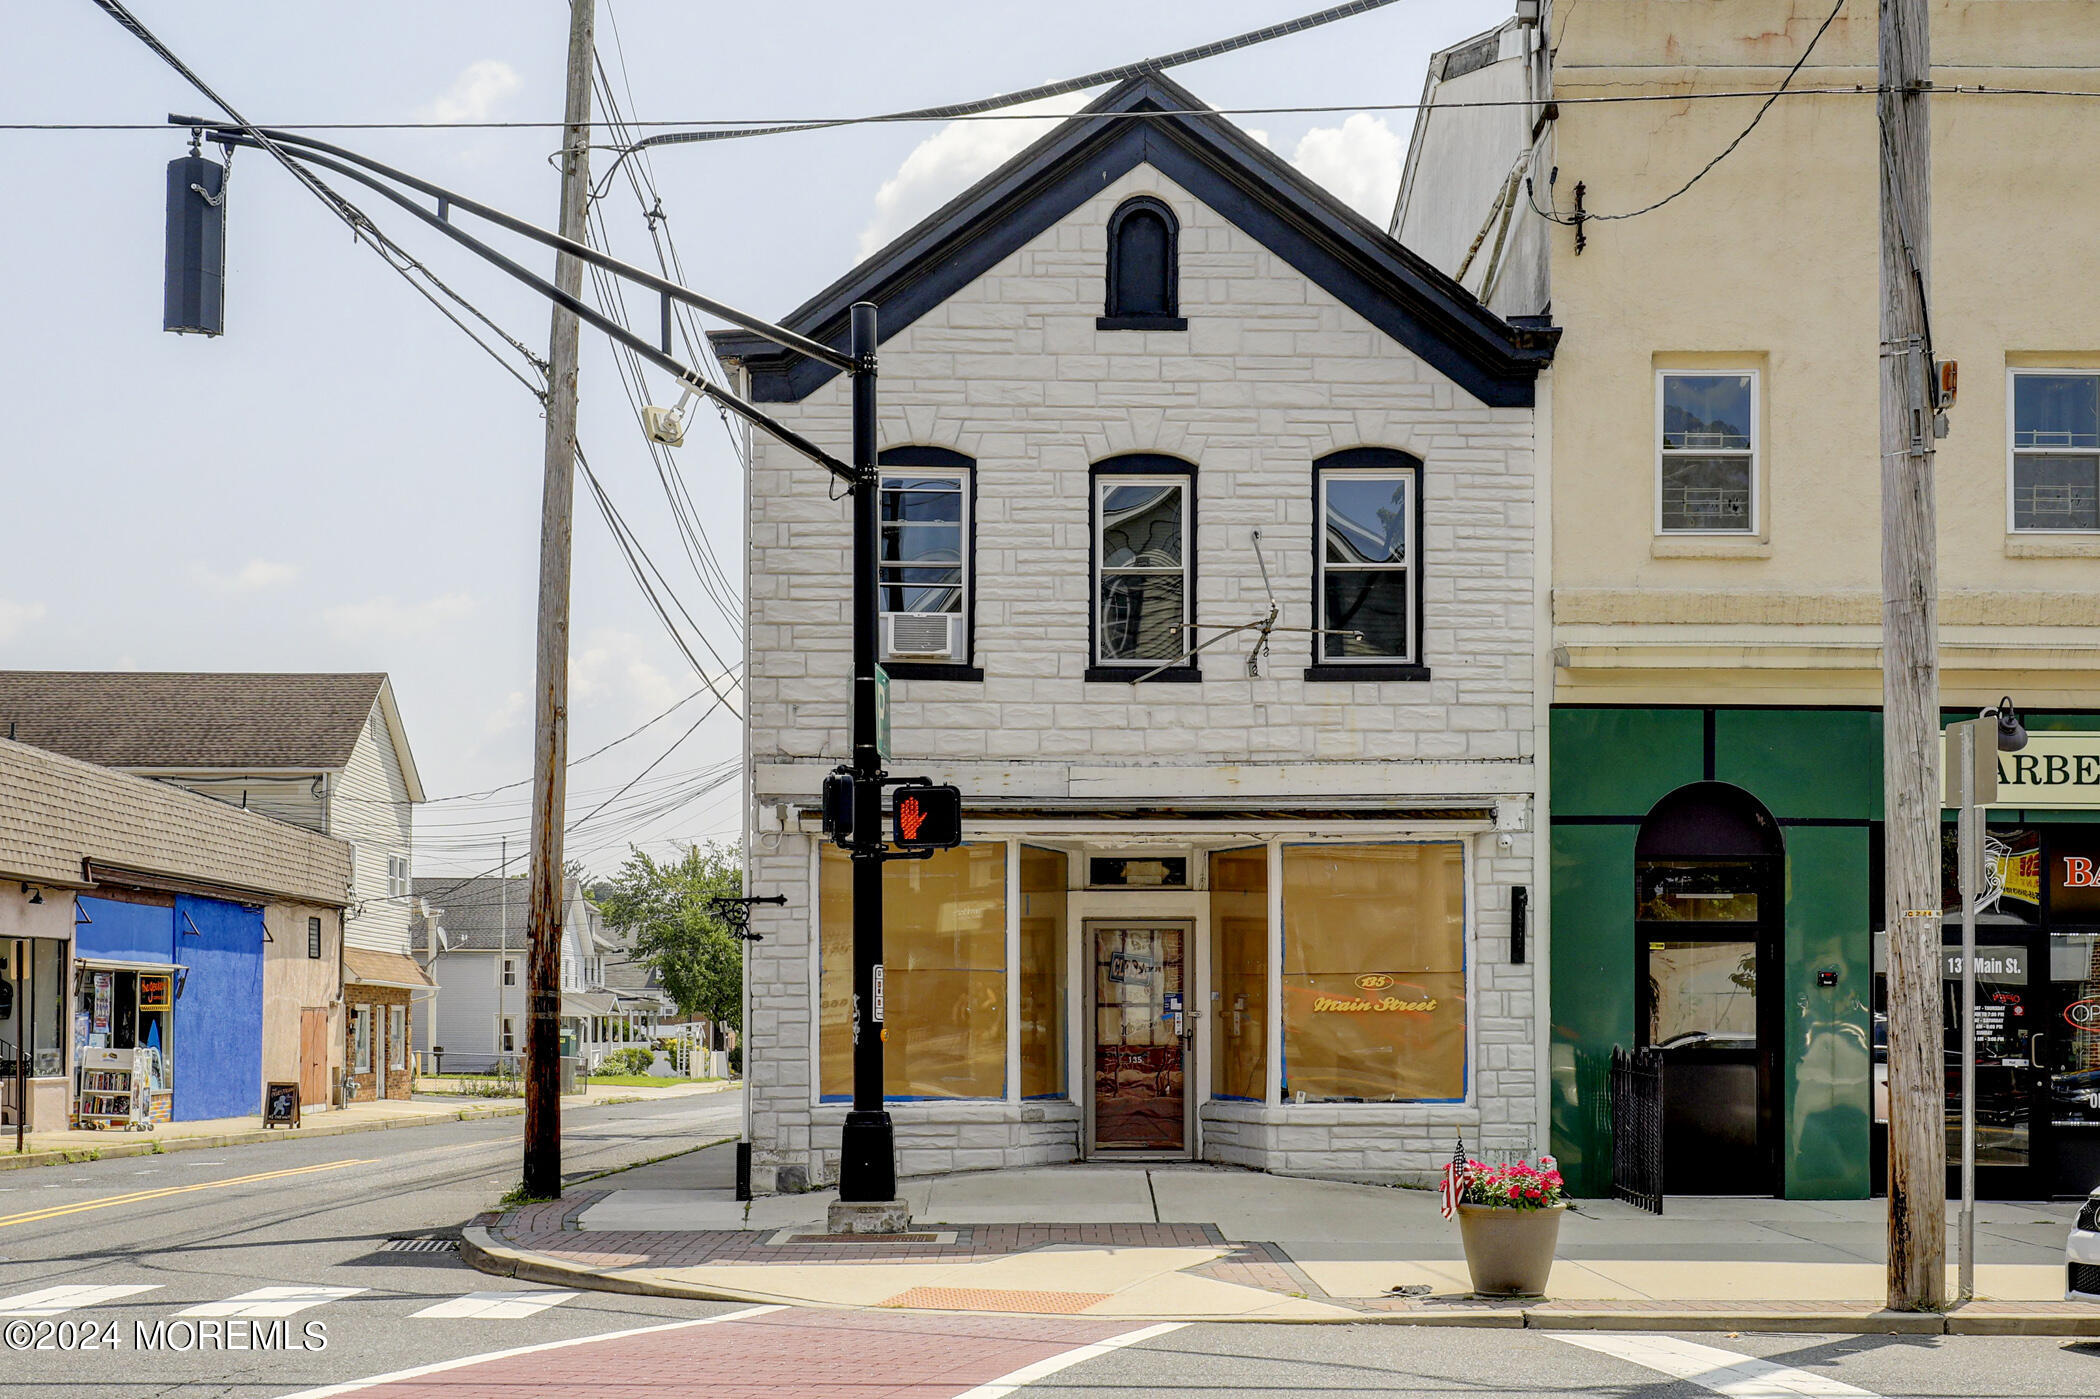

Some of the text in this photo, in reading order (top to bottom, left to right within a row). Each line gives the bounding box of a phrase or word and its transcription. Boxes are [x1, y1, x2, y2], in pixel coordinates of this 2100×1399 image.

[1947, 957, 2022, 974] 13 Main St.
[1361, 976, 1386, 987] 135
[1313, 996, 1438, 1012] Main Street
